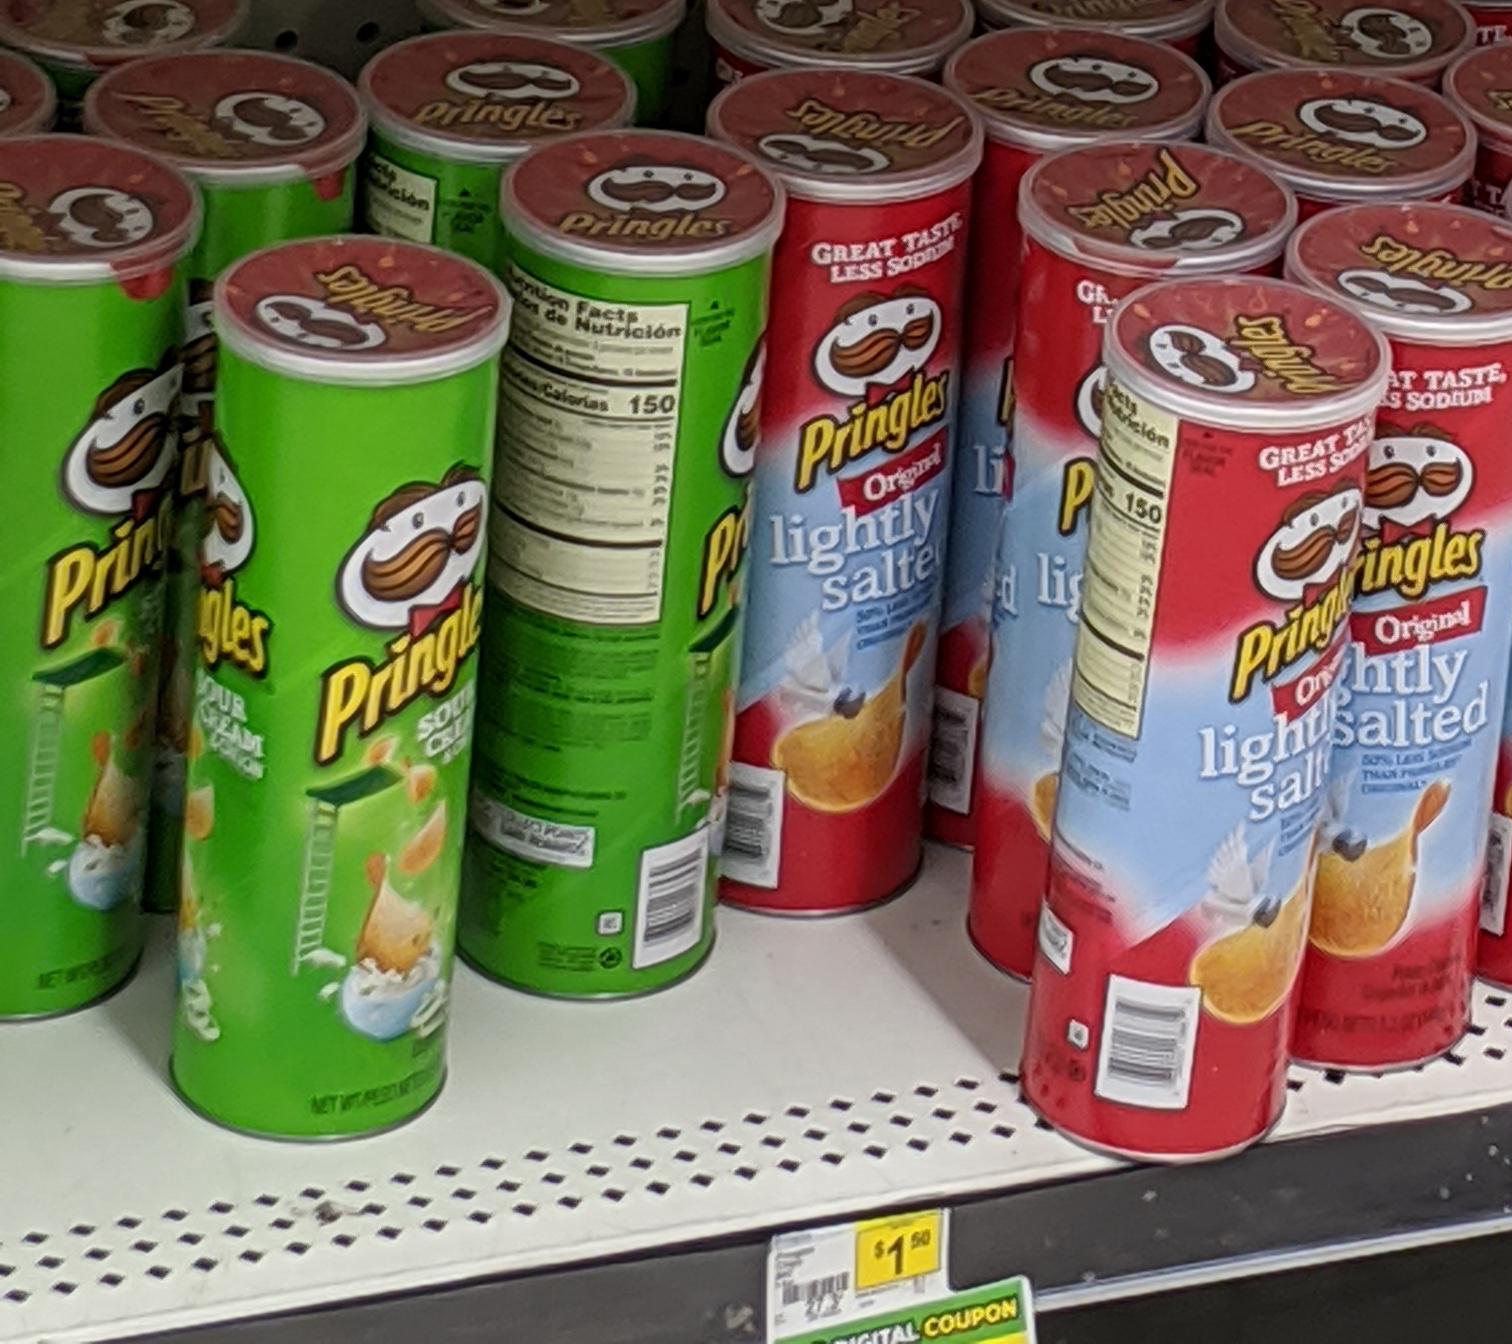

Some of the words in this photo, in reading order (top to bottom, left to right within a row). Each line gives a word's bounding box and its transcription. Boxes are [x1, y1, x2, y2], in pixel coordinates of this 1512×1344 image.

[413, 100, 581, 131] Pringles
[792, 100, 965, 151] Pringles
[1233, 118, 1401, 175] Pringles
[1081, 147, 1199, 230] Pringles
[559, 211, 732, 242] Pringles
[812, 239, 897, 267] GREAT
[830, 261, 884, 283] LESS
[574, 313, 683, 341] Nutrición
[576, 297, 639, 326] Facts
[628, 394, 677, 415] 150
[1405, 386, 1493, 413] SODIUM
[796, 369, 949, 491] Pringles
[1258, 435, 1338, 473] GREAT
[1277, 461, 1328, 488] LESS
[1126, 490, 1164, 524] 150
[770, 488, 940, 575] lightly
[1357, 522, 1485, 600] ringles
[1374, 601, 1472, 646] Original
[316, 581, 484, 766] Pringle
[1329, 681, 1489, 750] salted
[923, 1292, 1018, 1337] COUPON
